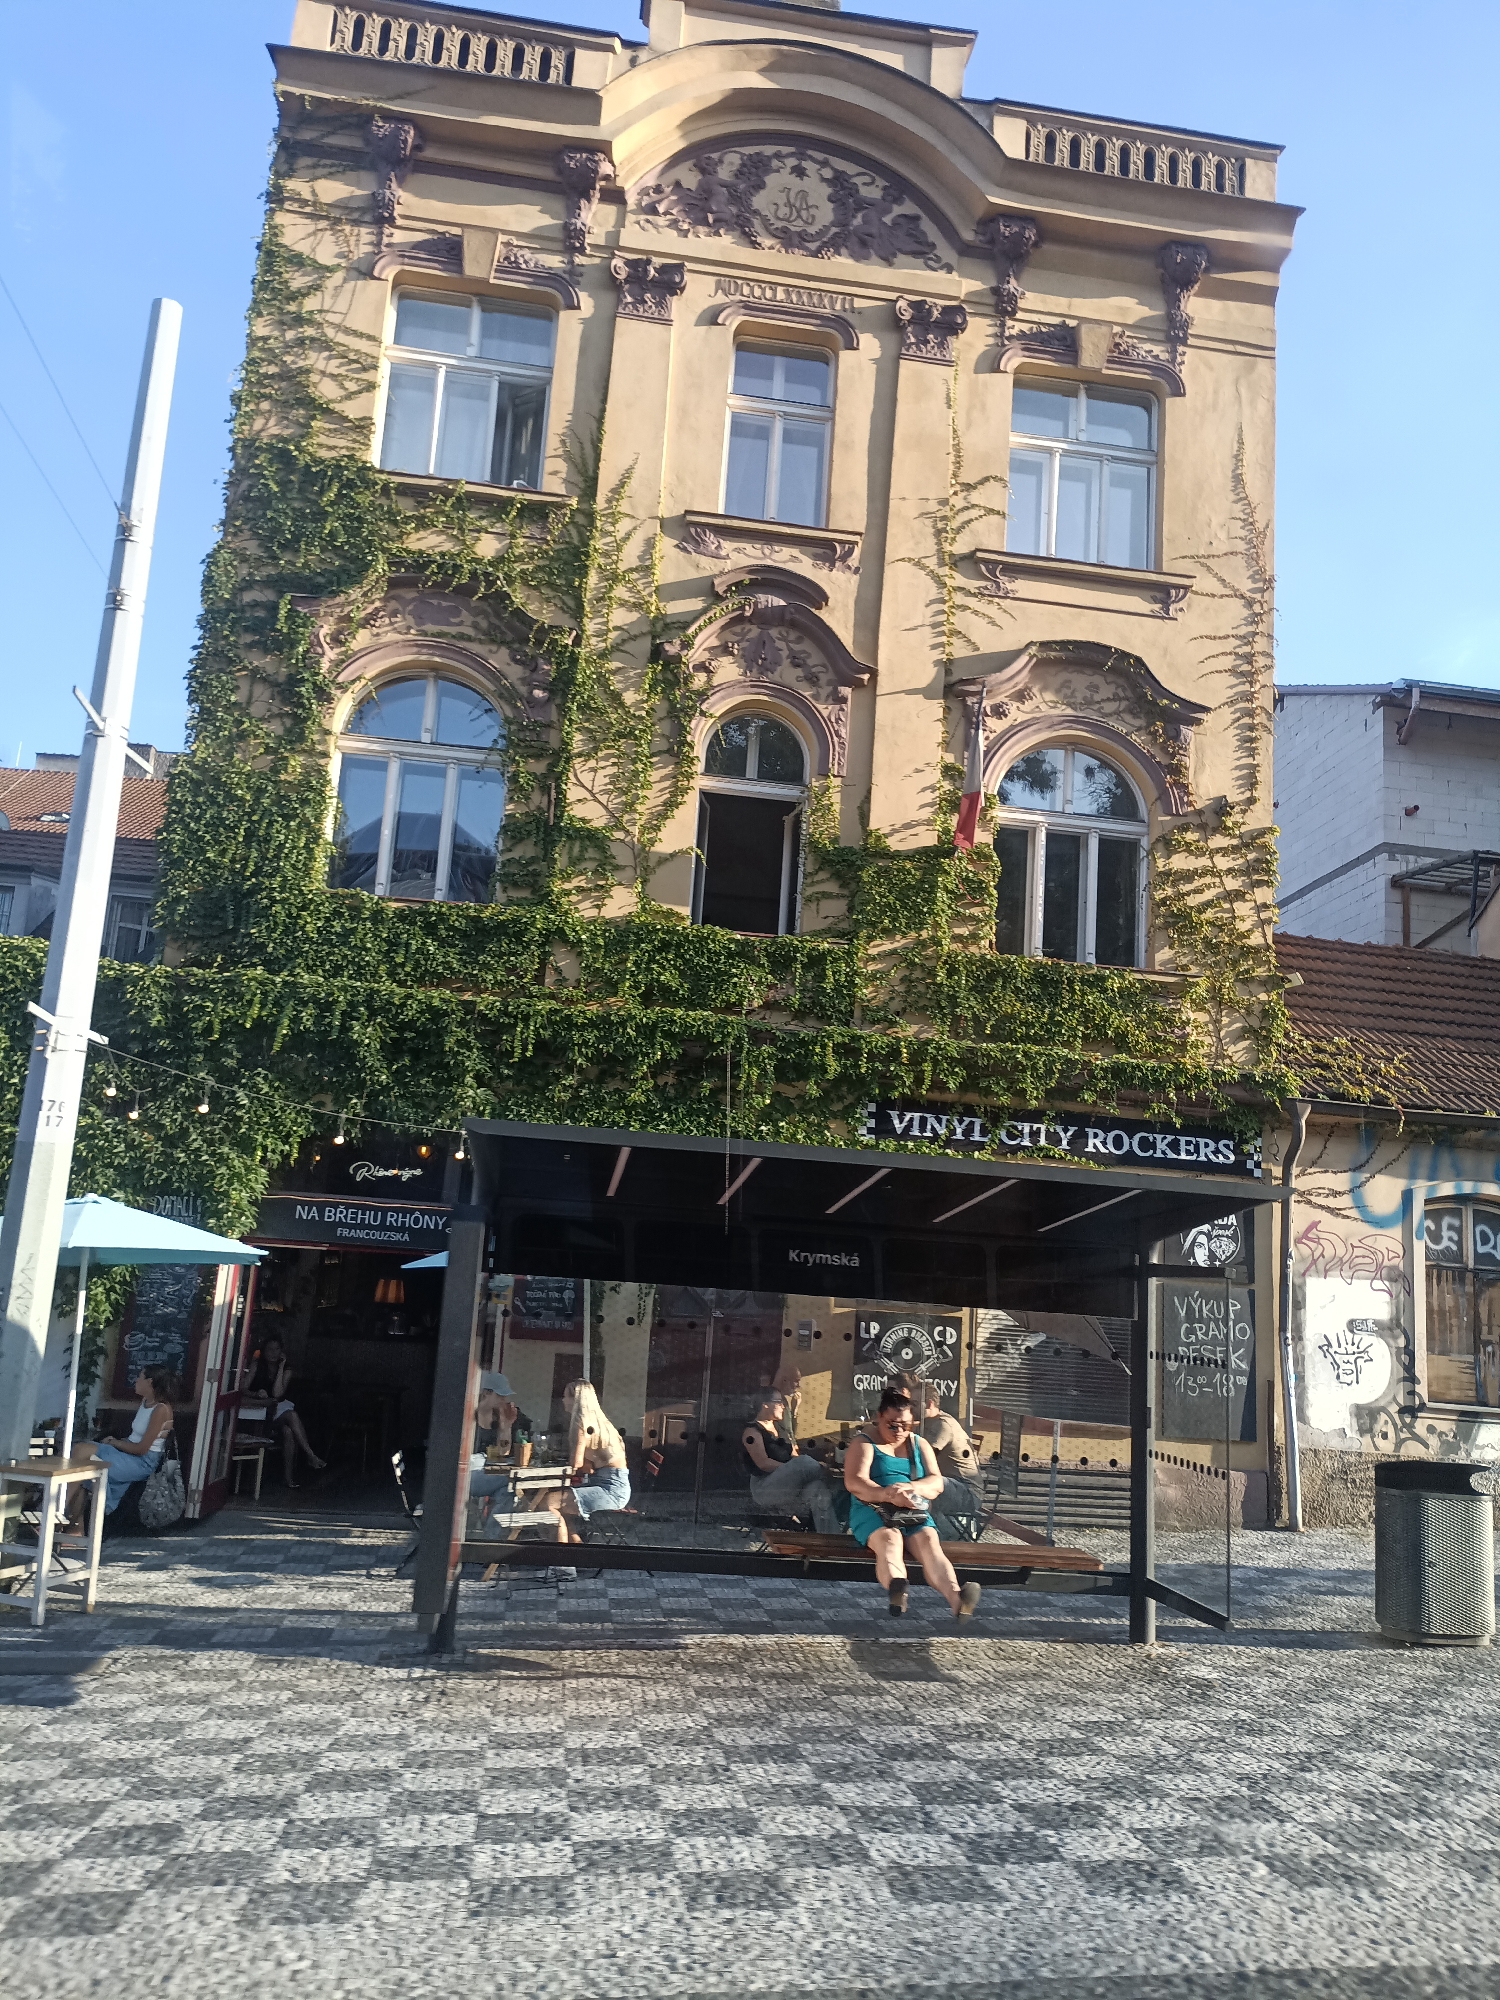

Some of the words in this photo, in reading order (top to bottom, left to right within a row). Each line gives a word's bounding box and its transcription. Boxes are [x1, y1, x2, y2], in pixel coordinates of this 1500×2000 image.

[886, 1110, 991, 1142] VINYL
[1000, 1121, 1078, 1150] CITY
[1084, 1127, 1236, 1165] ROCKERS
[295, 1205, 319, 1221] NA
[324, 1205, 382, 1226] BŘEHU
[386, 1211, 447, 1230] RHÔNY
[336, 1227, 410, 1242] FRANCOUZSKÁ
[788, 1249, 860, 1267] Krymská
[1174, 1291, 1242, 1319] VÝKUP
[860, 1321, 881, 1339] LP
[933, 1326, 958, 1345] CD
[1181, 1320, 1250, 1342] GRAMO
